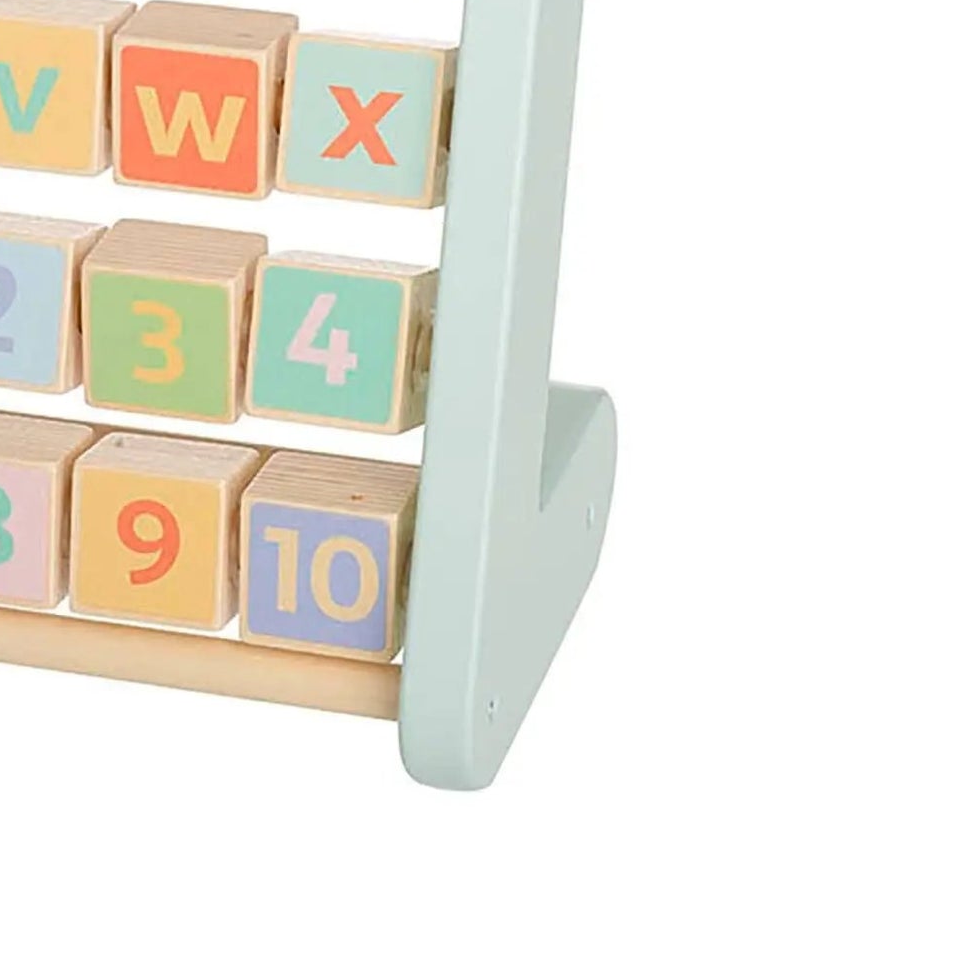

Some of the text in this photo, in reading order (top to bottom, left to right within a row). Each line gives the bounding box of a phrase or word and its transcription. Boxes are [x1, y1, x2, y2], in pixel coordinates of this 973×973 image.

[135, 85, 246, 163] w
[320, 84, 405, 165] x
[131, 301, 184, 383] 3
[287, 292, 358, 386] 4
[116, 499, 181, 585] 9
[263, 526, 379, 623] 10
